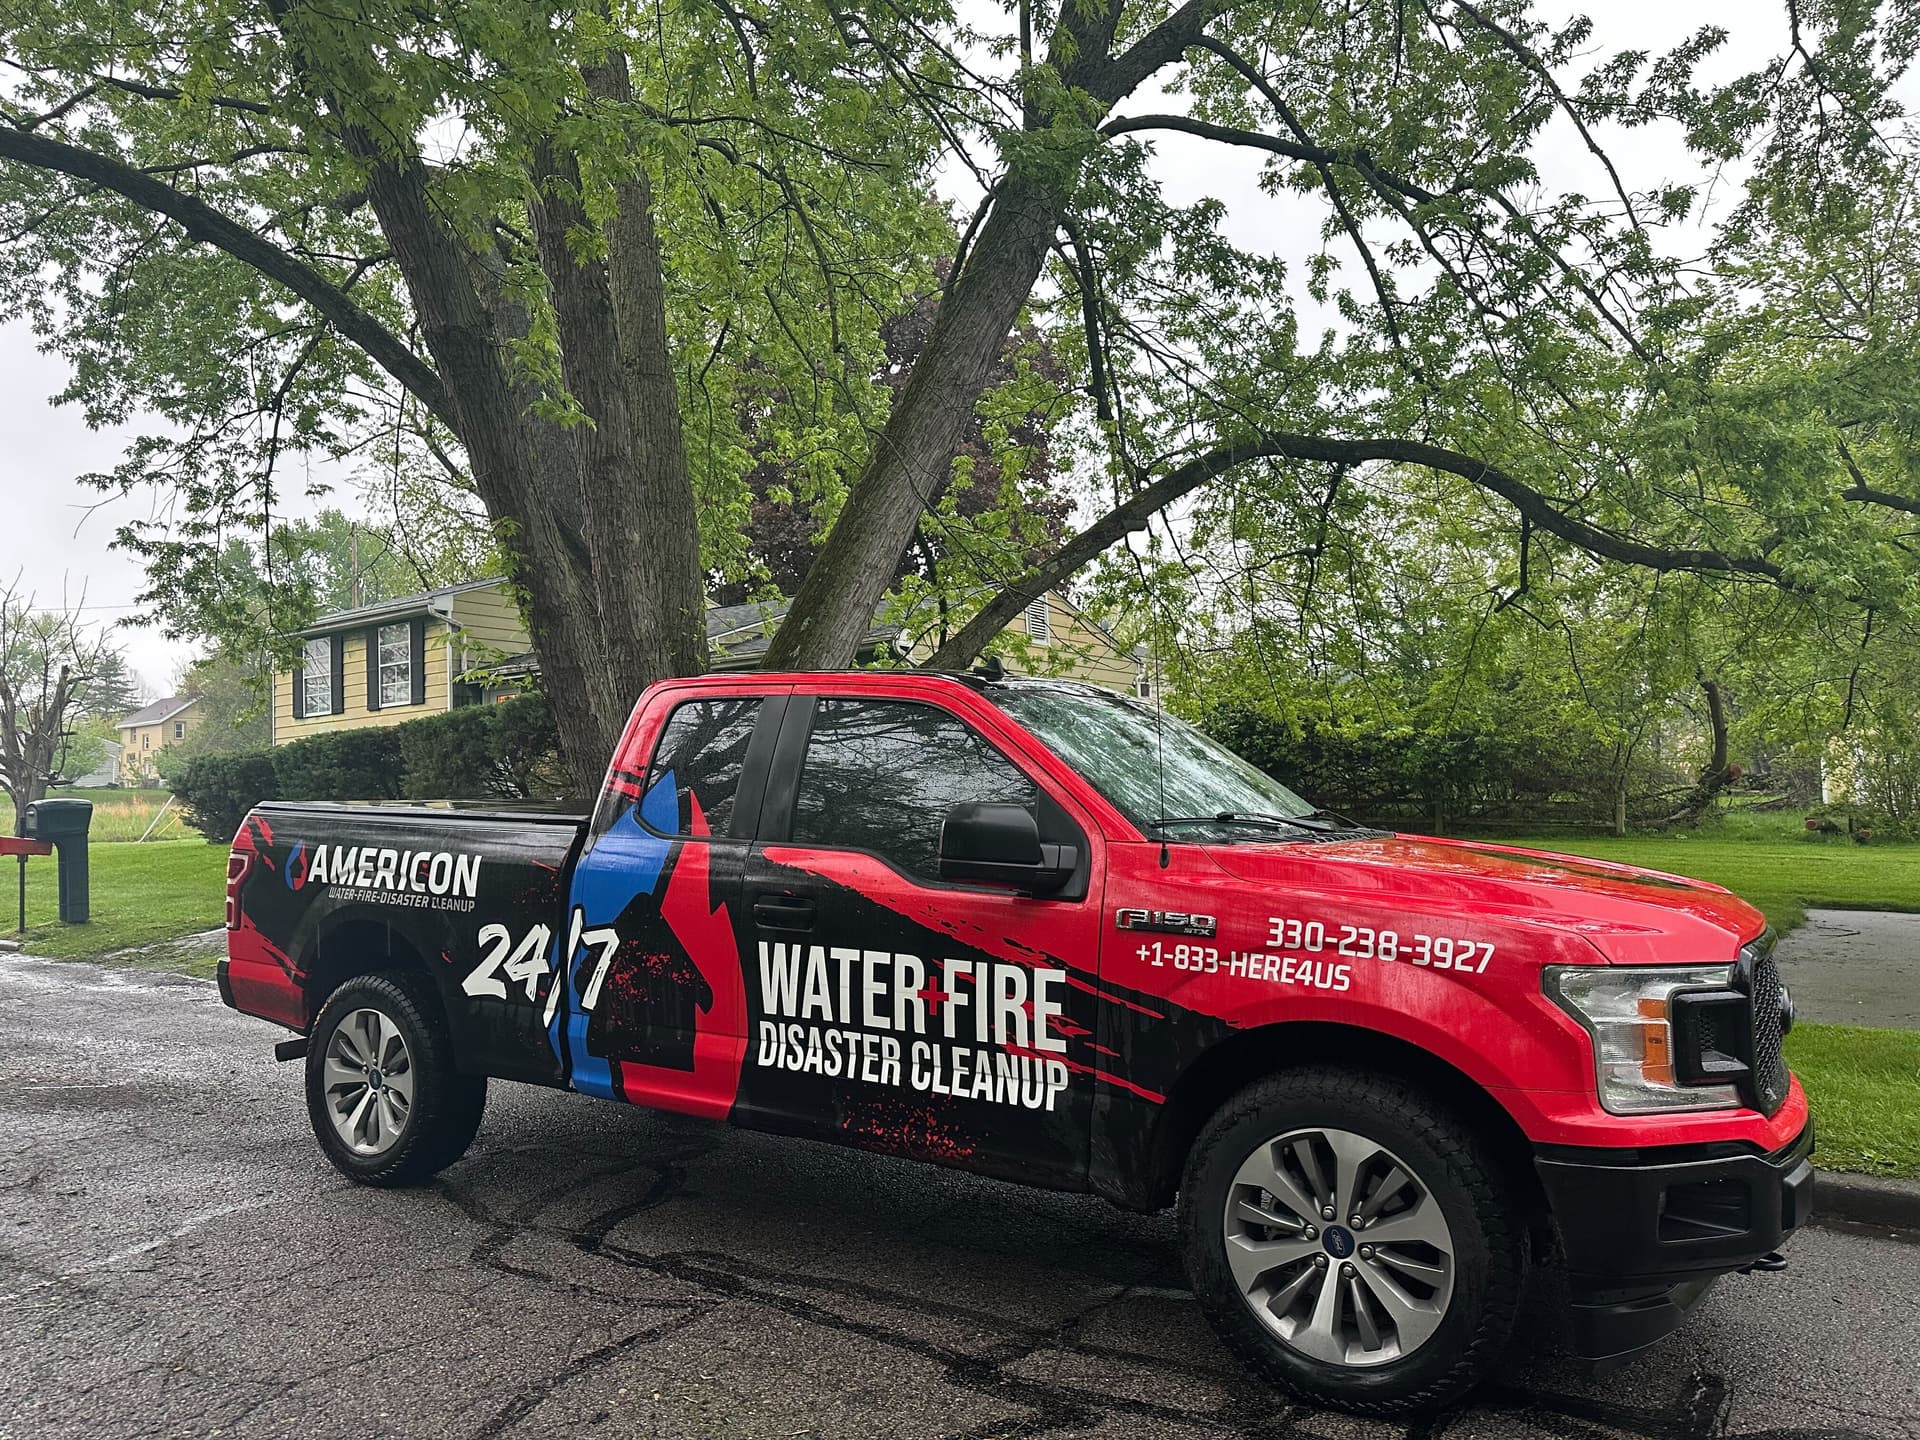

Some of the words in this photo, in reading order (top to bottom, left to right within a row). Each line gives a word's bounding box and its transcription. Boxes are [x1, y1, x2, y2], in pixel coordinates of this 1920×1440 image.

[307, 844, 482, 897] AMERICON
[328, 887, 429, 908] WATER-FIRE-DISASTER
[431, 897, 475, 913] CLEANUP
[461, 908, 620, 1028] 24/7
[1136, 942, 1351, 991] +1-833-HERE4US
[1266, 917, 1495, 974] 330-238-3927
[757, 1021, 901, 1086] DISASTER
[911, 1041, 1069, 1112] CLEANUP
